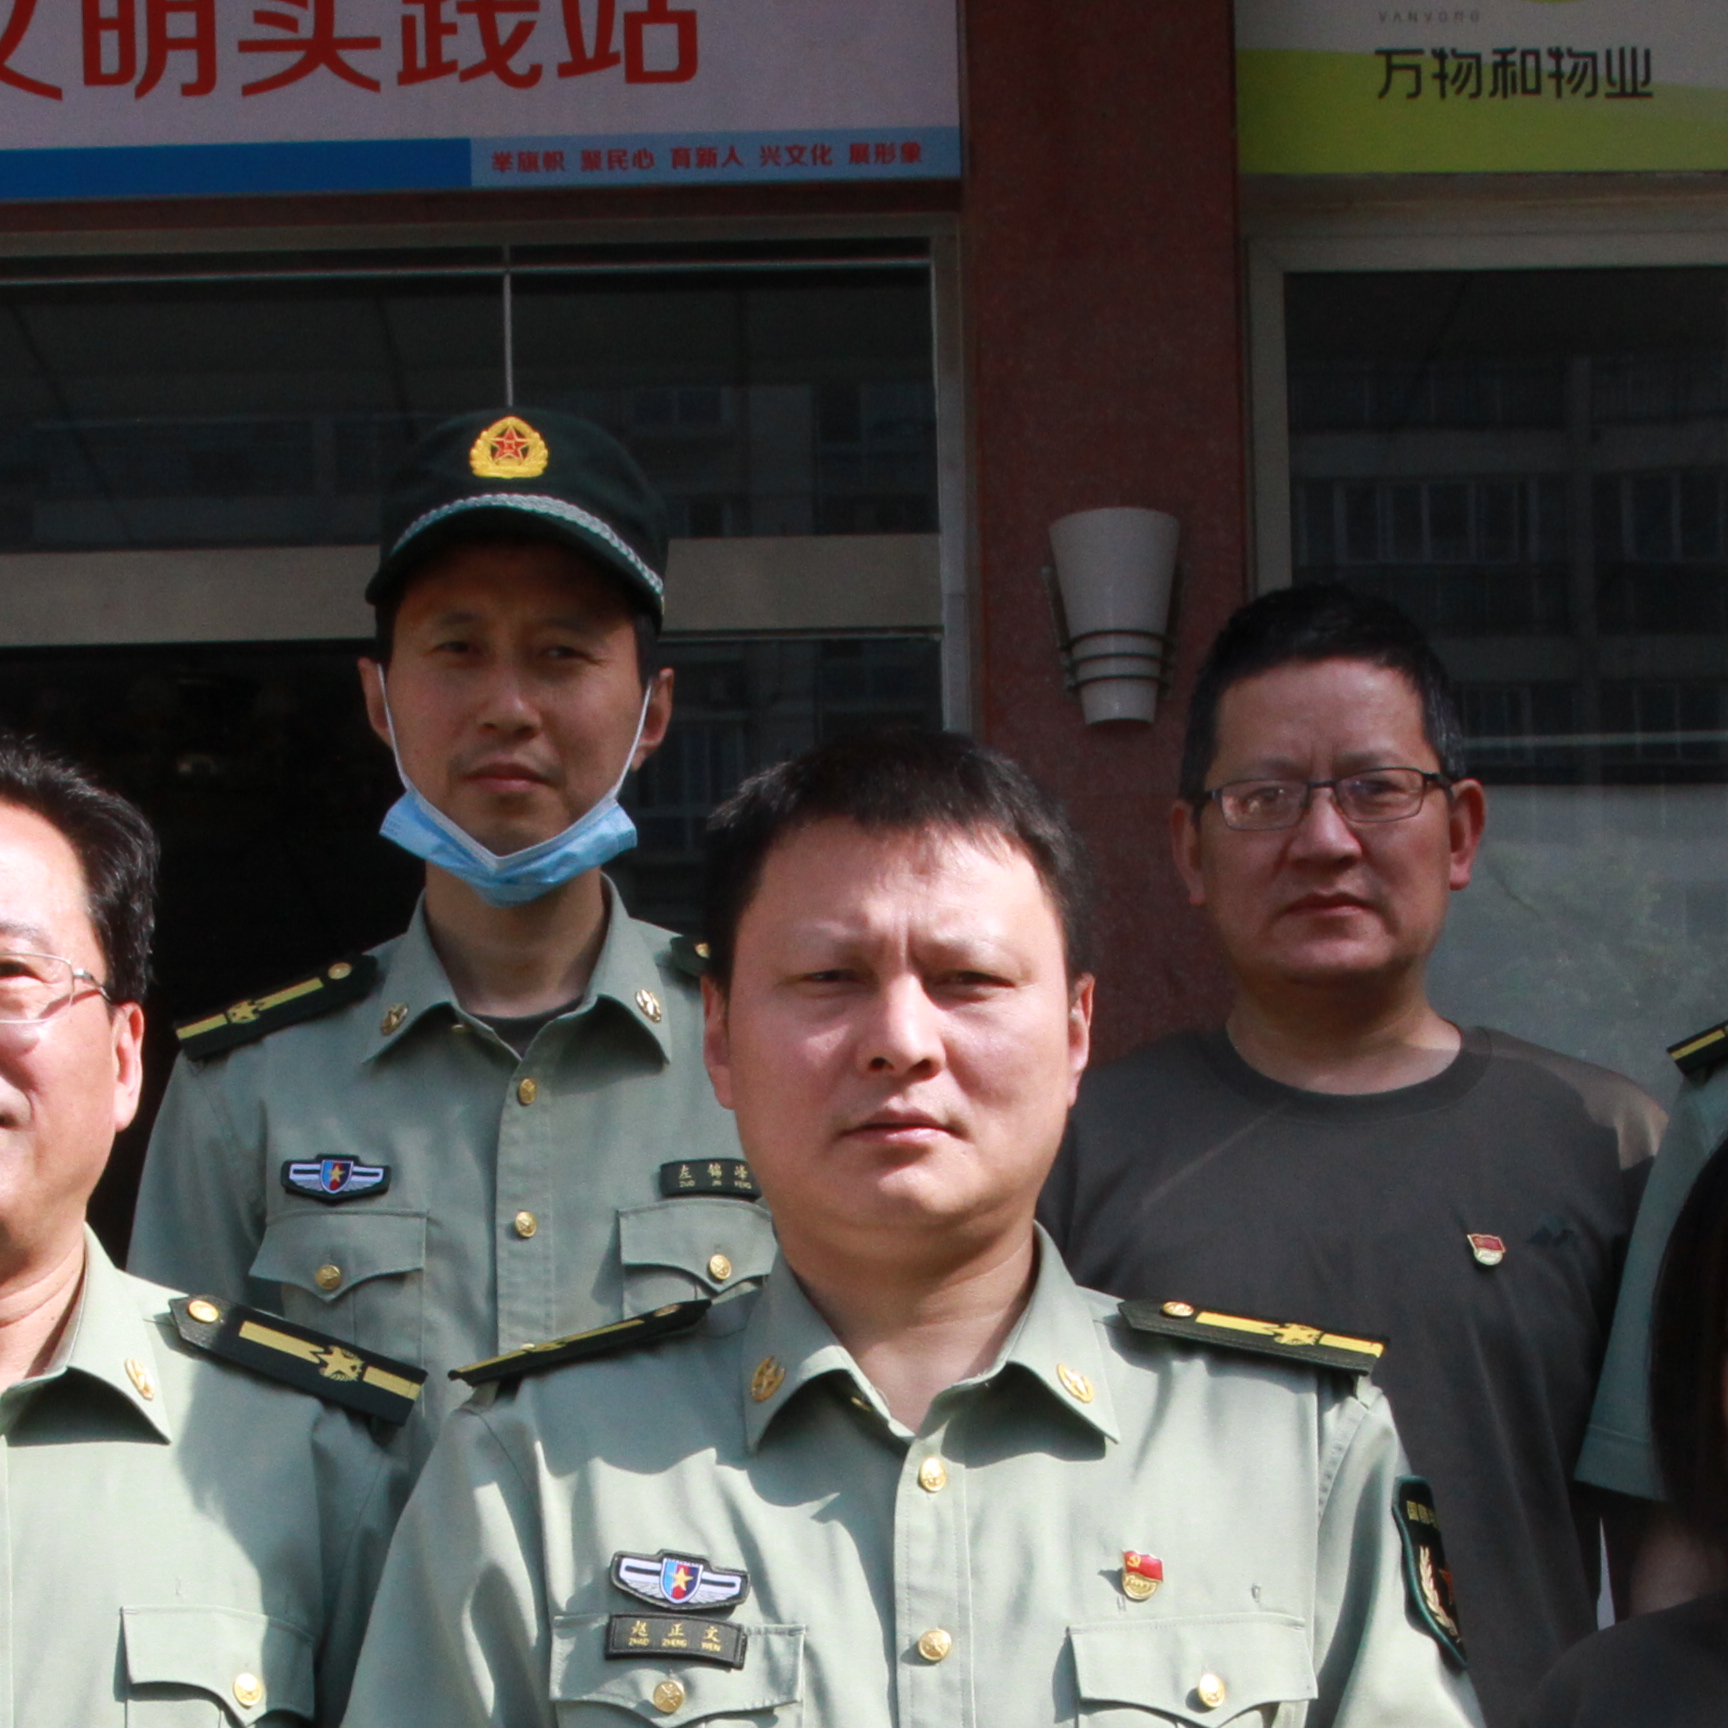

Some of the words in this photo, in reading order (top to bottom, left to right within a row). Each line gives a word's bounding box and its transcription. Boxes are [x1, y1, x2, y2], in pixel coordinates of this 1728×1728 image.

[1374, 47, 1653, 100] 万物和物业
[491, 150, 565, 173] 举旗帜
[580, 148, 655, 172] 聚民心
[670, 146, 744, 170] 育新人
[759, 144, 833, 168] 兴文化
